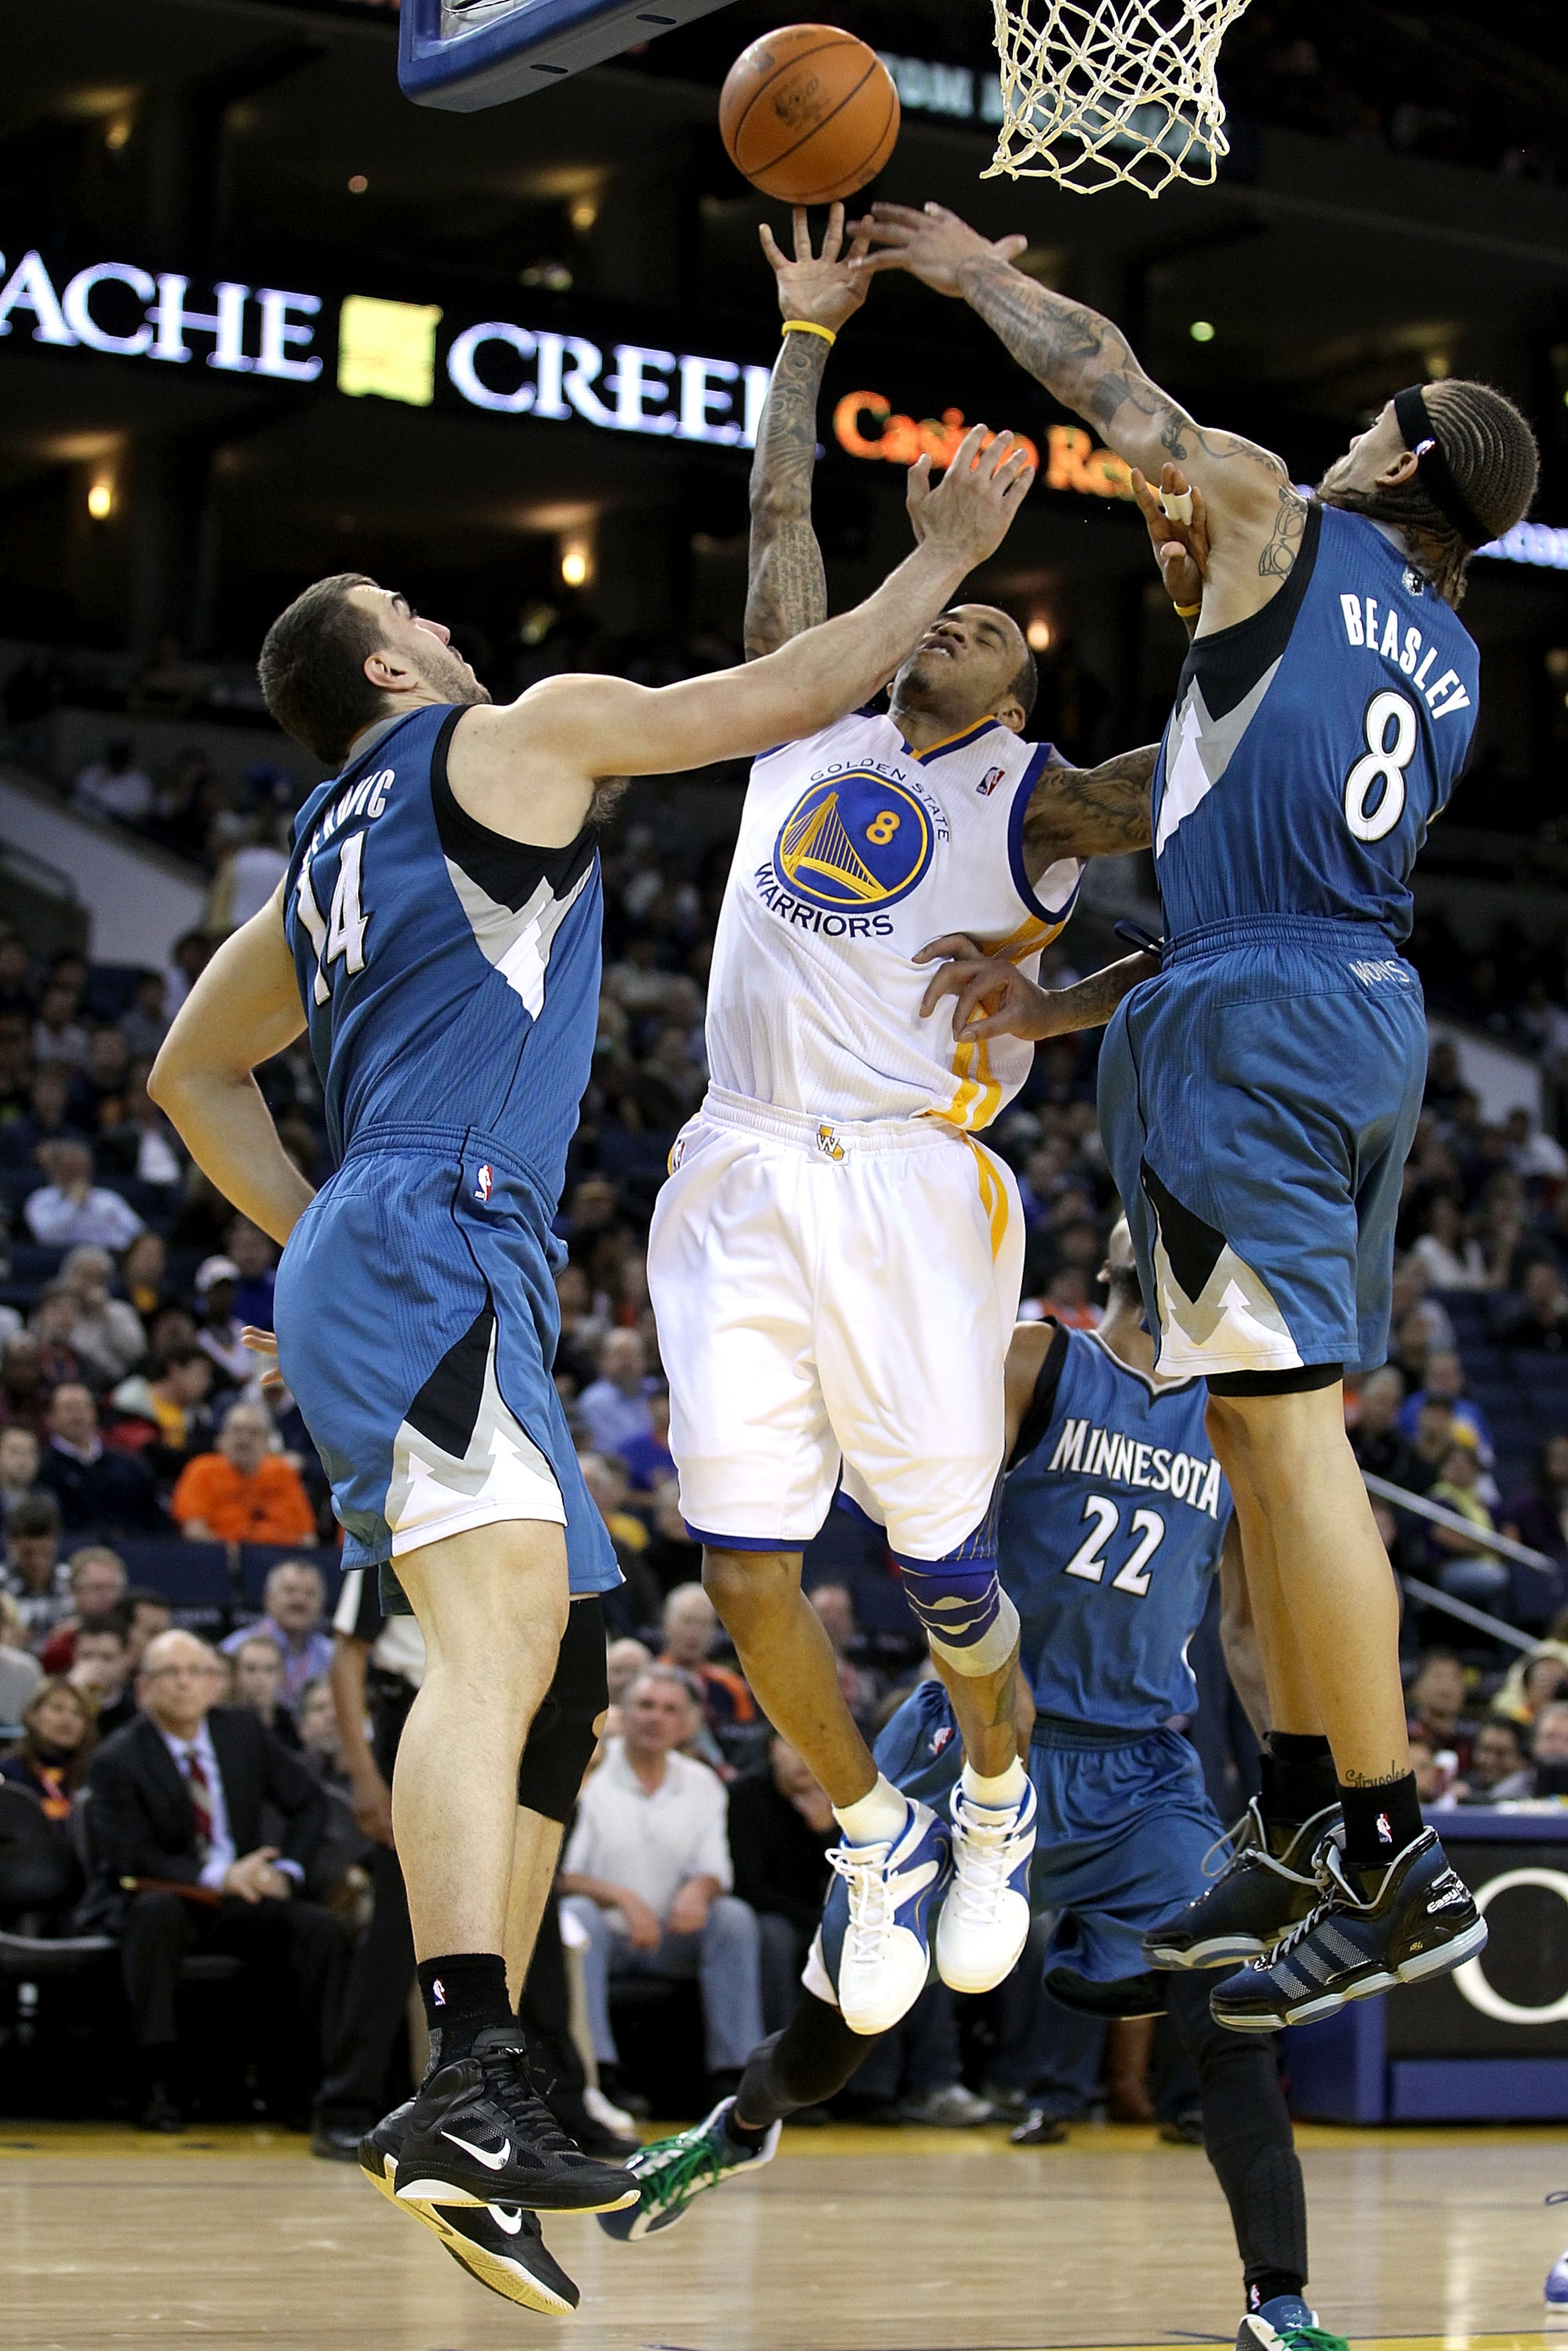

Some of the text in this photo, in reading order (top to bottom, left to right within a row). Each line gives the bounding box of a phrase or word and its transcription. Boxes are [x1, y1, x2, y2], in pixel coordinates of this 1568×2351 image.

[0, 251, 323, 382] ACHE
[1340, 594, 1471, 720] BEASLEY
[810, 758, 951, 843] GOLDEN STATE
[1345, 690, 1417, 843] 8
[866, 810, 901, 845] 8
[296, 829, 369, 1006] 14
[754, 860, 894, 938] WARRIORS
[1048, 1418, 1221, 1520] MINNESOTA
[1064, 1494, 1165, 1596] 22
